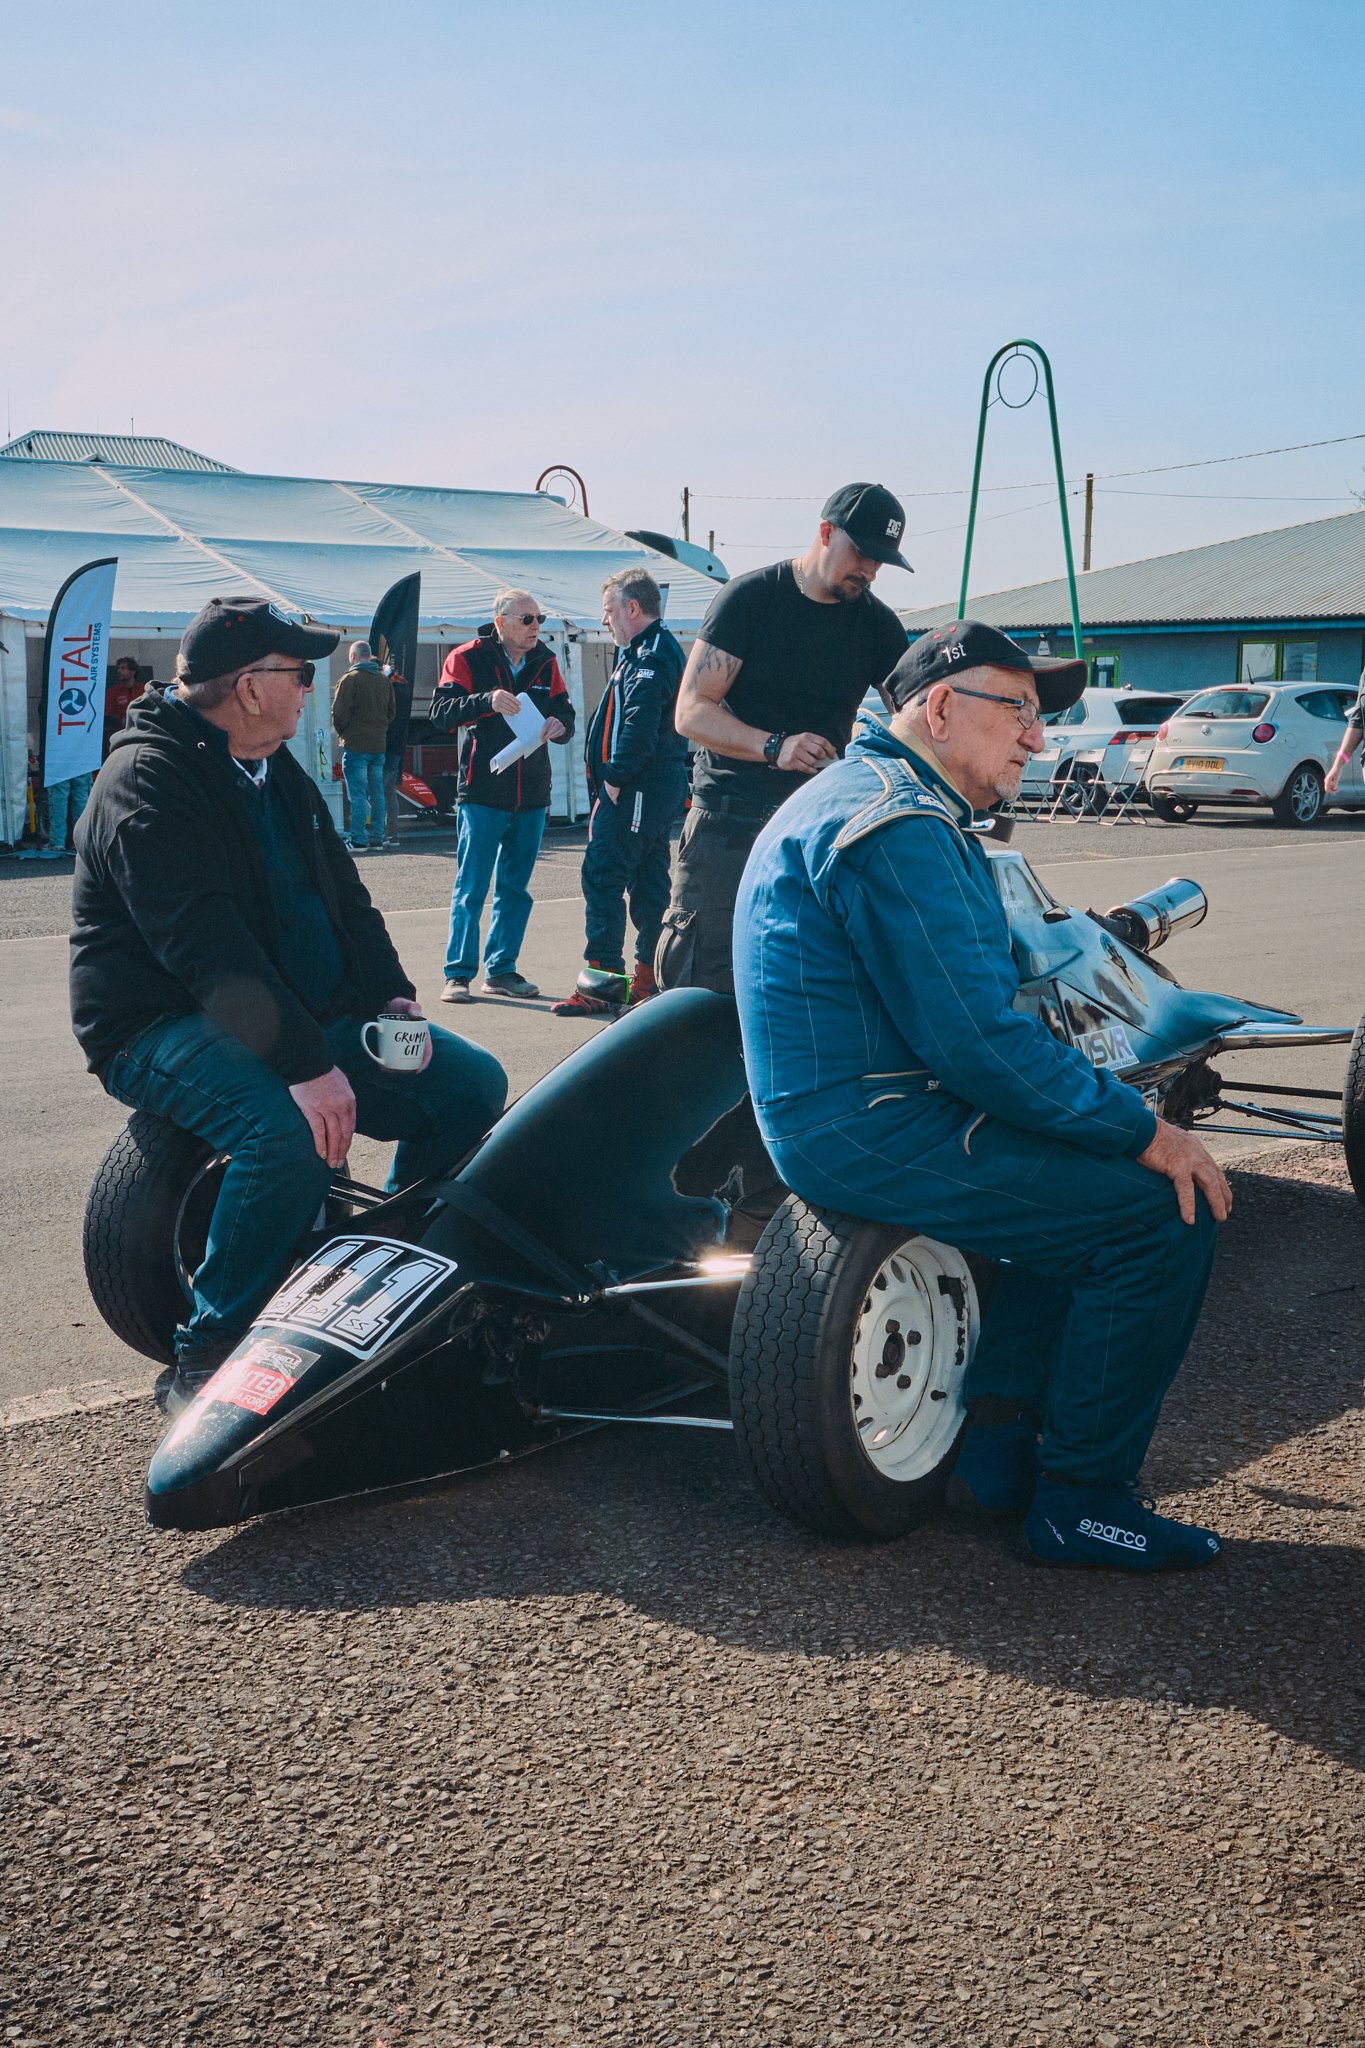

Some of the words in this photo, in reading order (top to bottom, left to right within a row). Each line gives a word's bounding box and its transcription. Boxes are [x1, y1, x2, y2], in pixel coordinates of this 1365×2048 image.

[886, 518, 902, 536] DC
[91, 622, 102, 664] SYSTEMS
[942, 642, 966, 664] 1st
[57, 623, 93, 735] TOTAL
[90, 663, 98, 681] AIR
[637, 670, 655, 678] OMP
[404, 1044, 420, 1057] GIT
[256, 1240, 446, 1346] 111
[305, 1304, 329, 1317] DA
[345, 1318, 370, 1331] SS
[243, 1394, 268, 1409] FORD
[1079, 1518, 1147, 1548] sparco
